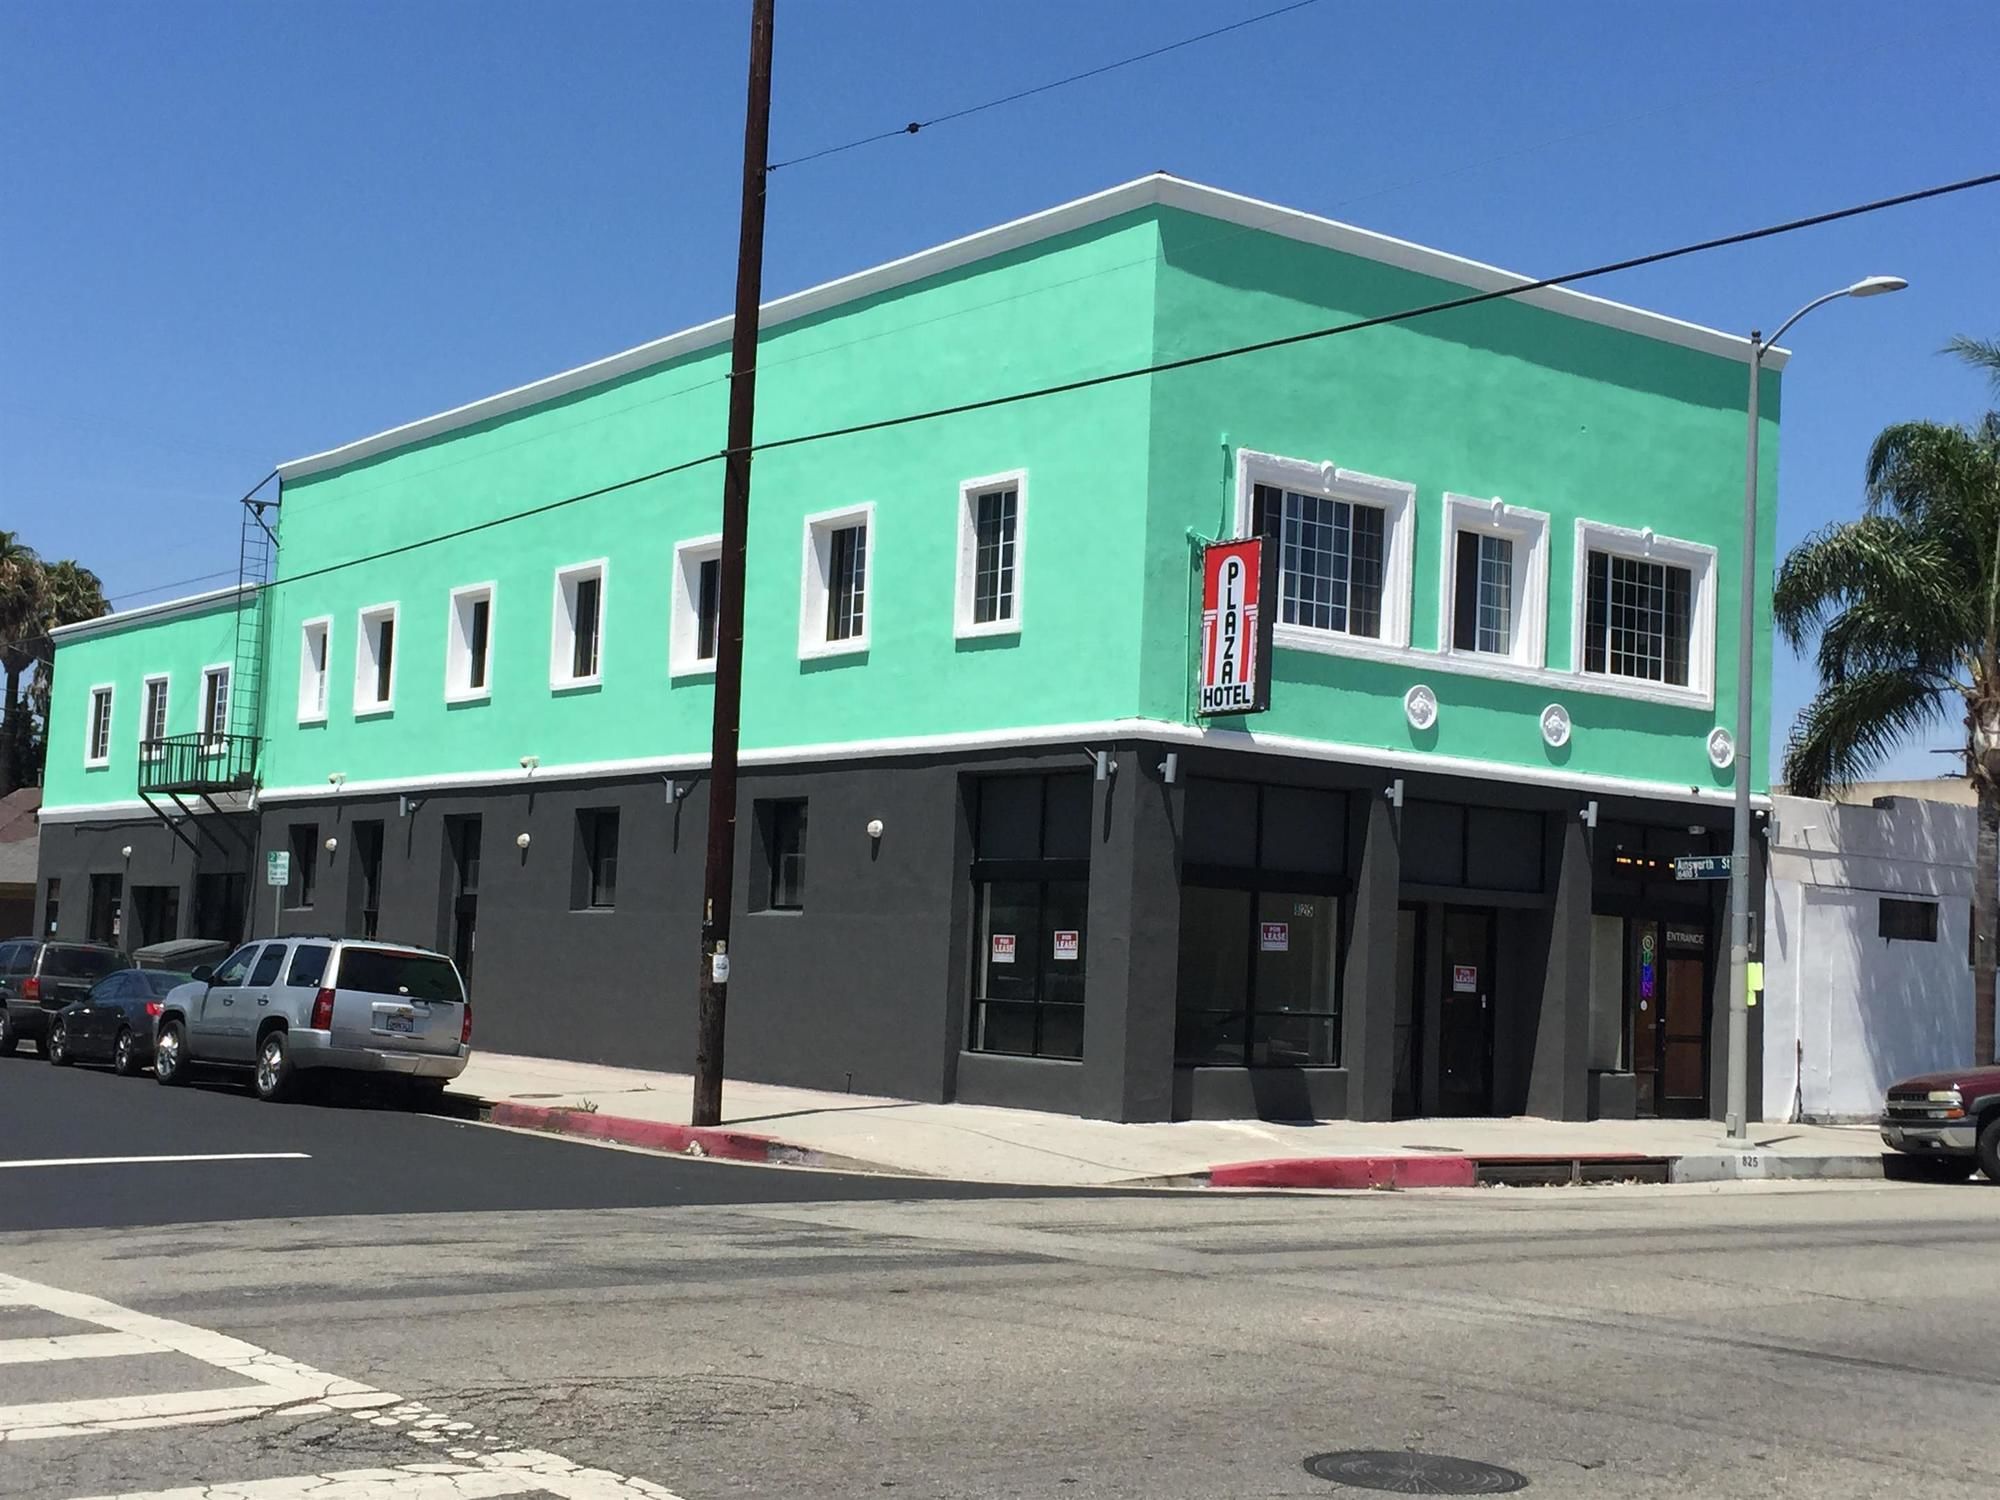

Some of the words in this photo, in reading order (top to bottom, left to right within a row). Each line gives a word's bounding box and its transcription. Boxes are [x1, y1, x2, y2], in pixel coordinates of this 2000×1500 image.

[1221, 562, 1239, 684] PLAZA
[1203, 685, 1250, 708] HOTEL
[1677, 859, 1714, 870] Ainsworth
[1721, 857, 1731, 869] St
[1263, 932, 1286, 940] LEASE
[1666, 931, 1704, 944] ENTRANCE
[995, 944, 1013, 952] LEASE
[1056, 940, 1076, 949] LEASE
[1455, 975, 1474, 983] LEASE
[1742, 1156, 1758, 1167] 825
